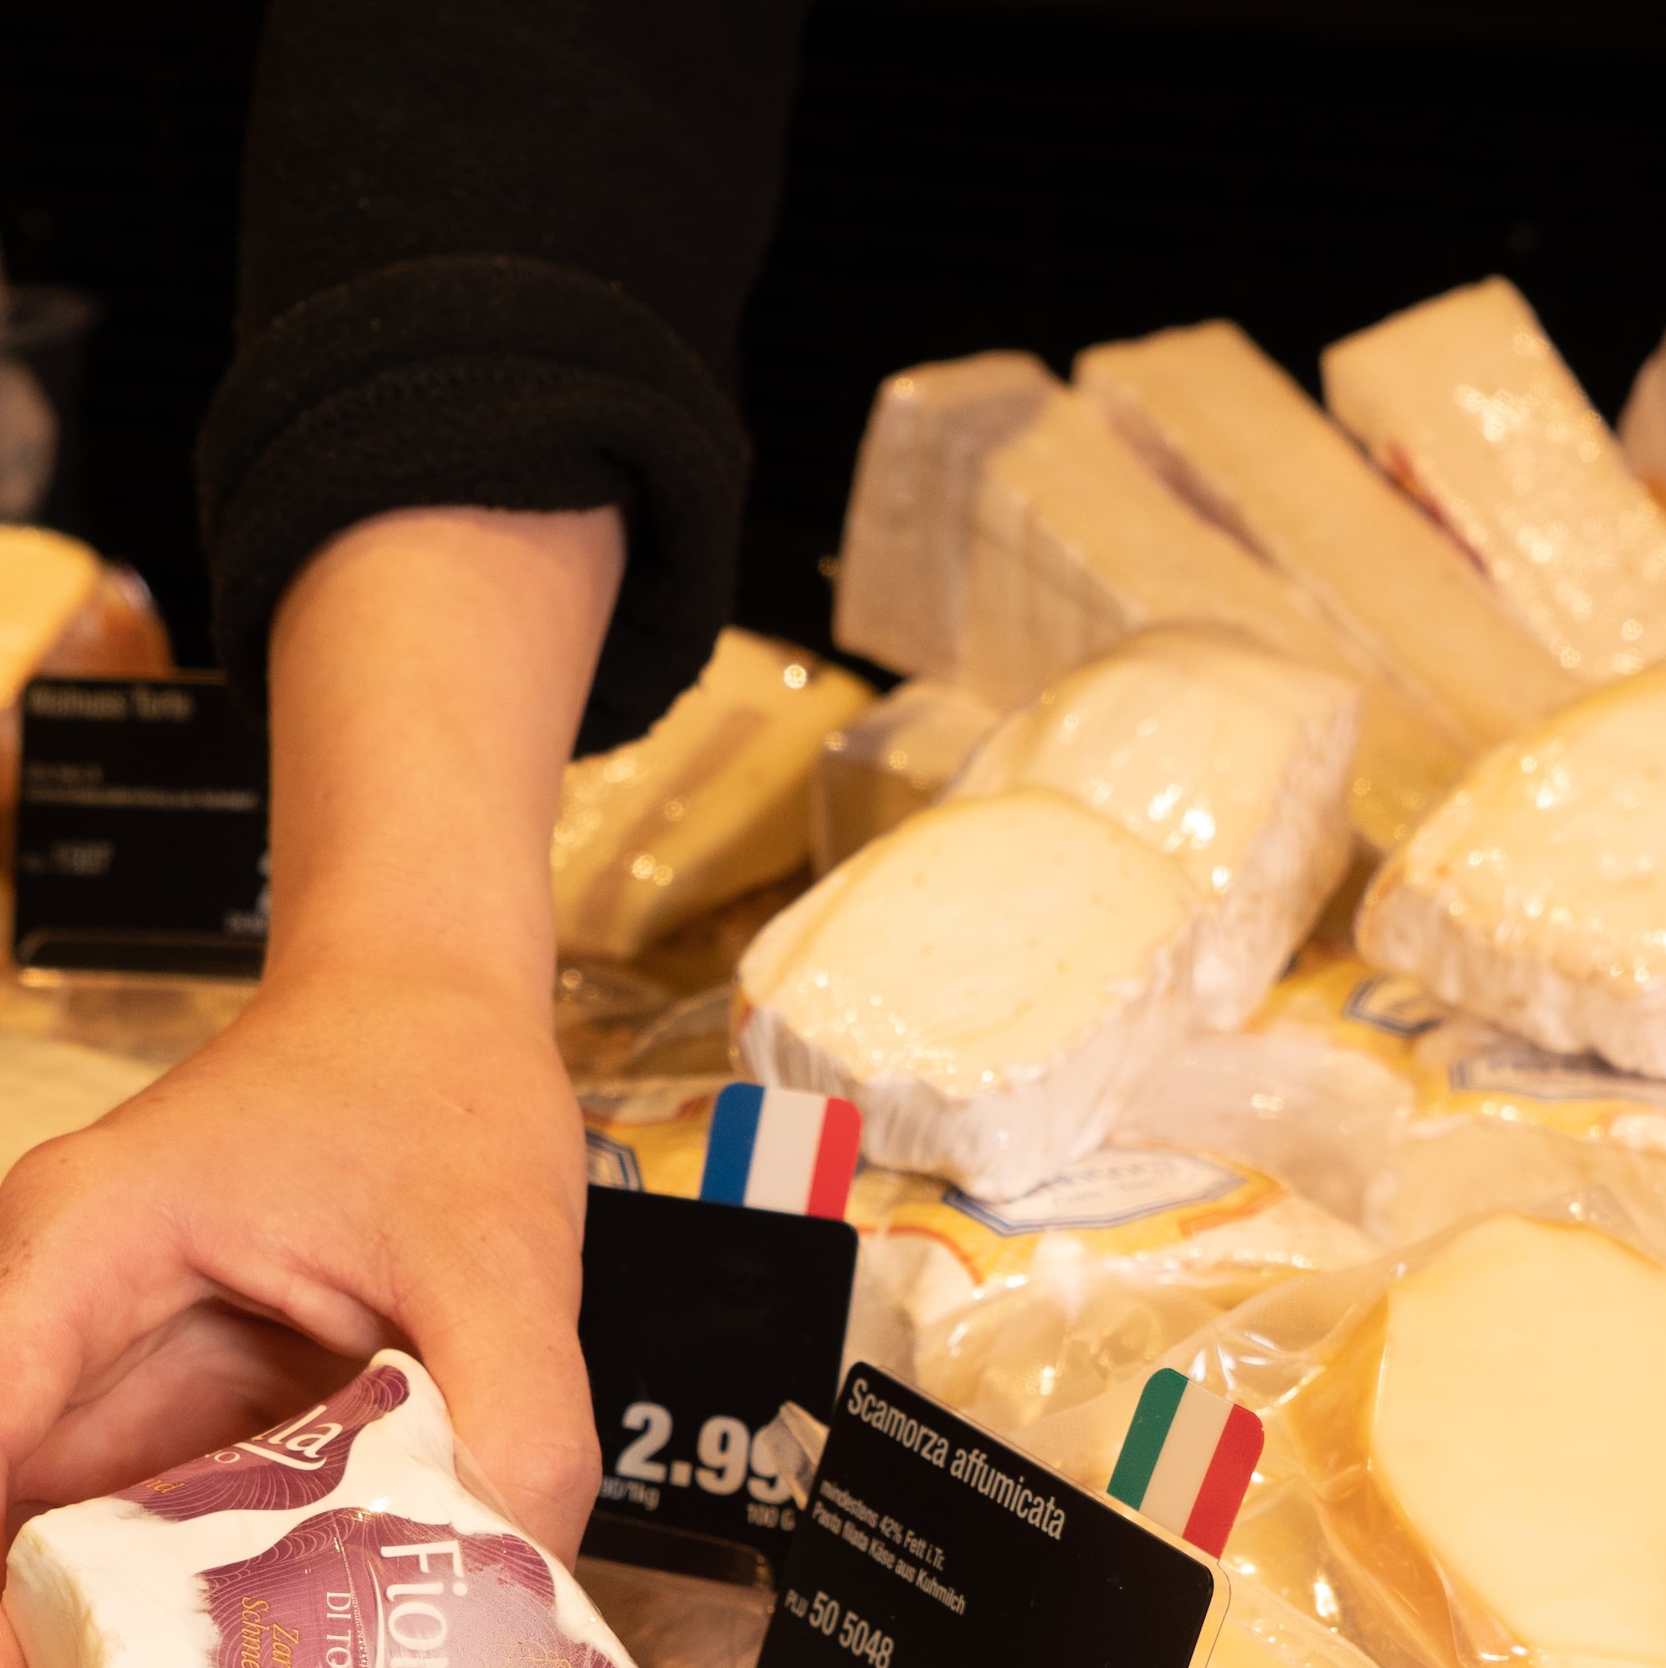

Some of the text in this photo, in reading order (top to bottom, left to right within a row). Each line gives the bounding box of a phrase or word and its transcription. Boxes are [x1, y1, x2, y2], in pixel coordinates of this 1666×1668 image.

[615, 1401, 797, 1504] 2.99
[847, 1377, 1067, 1540] Scamorza affumicata
[747, 1502, 796, 1531] 100 G
[819, 1479, 880, 1529] mindestens
[879, 1515, 904, 1545] 42%
[903, 1530, 928, 1560] Fett
[811, 1500, 967, 1616] Pasta filata Käse aus Kuhmilch
[326, 1591, 352, 1620] DI
[784, 1589, 809, 1618] PLU
[808, 1590, 840, 1636] 50
